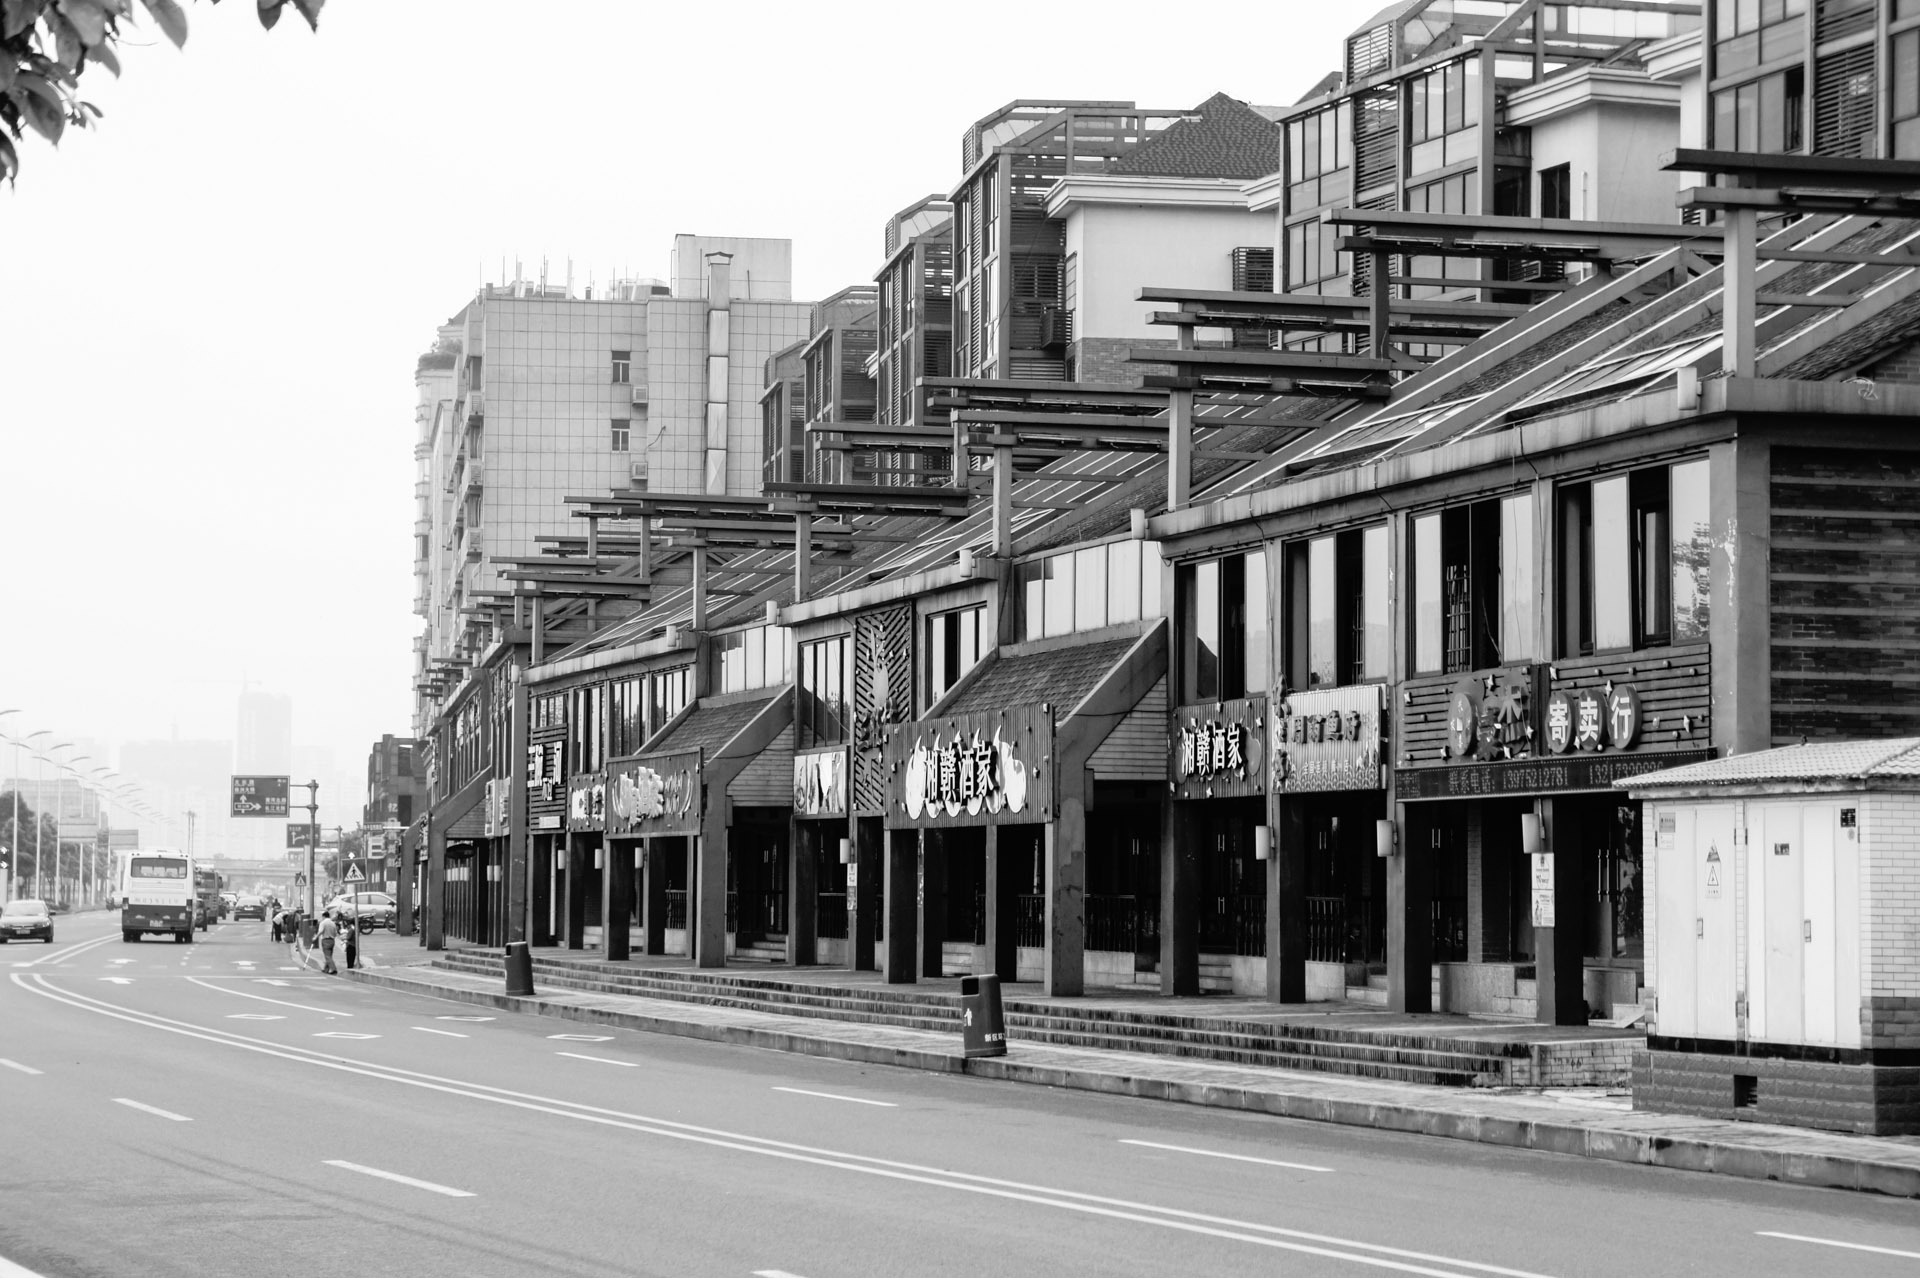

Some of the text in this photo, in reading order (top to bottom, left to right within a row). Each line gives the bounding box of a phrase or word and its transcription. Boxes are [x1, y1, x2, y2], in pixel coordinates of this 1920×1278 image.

[1549, 695, 1632, 744] 寄卖行
[922, 739, 995, 802] 湘赣酒家
[1181, 721, 1243, 777] 湘赣酒家
[1502, 766, 1569, 790] 13975212781
